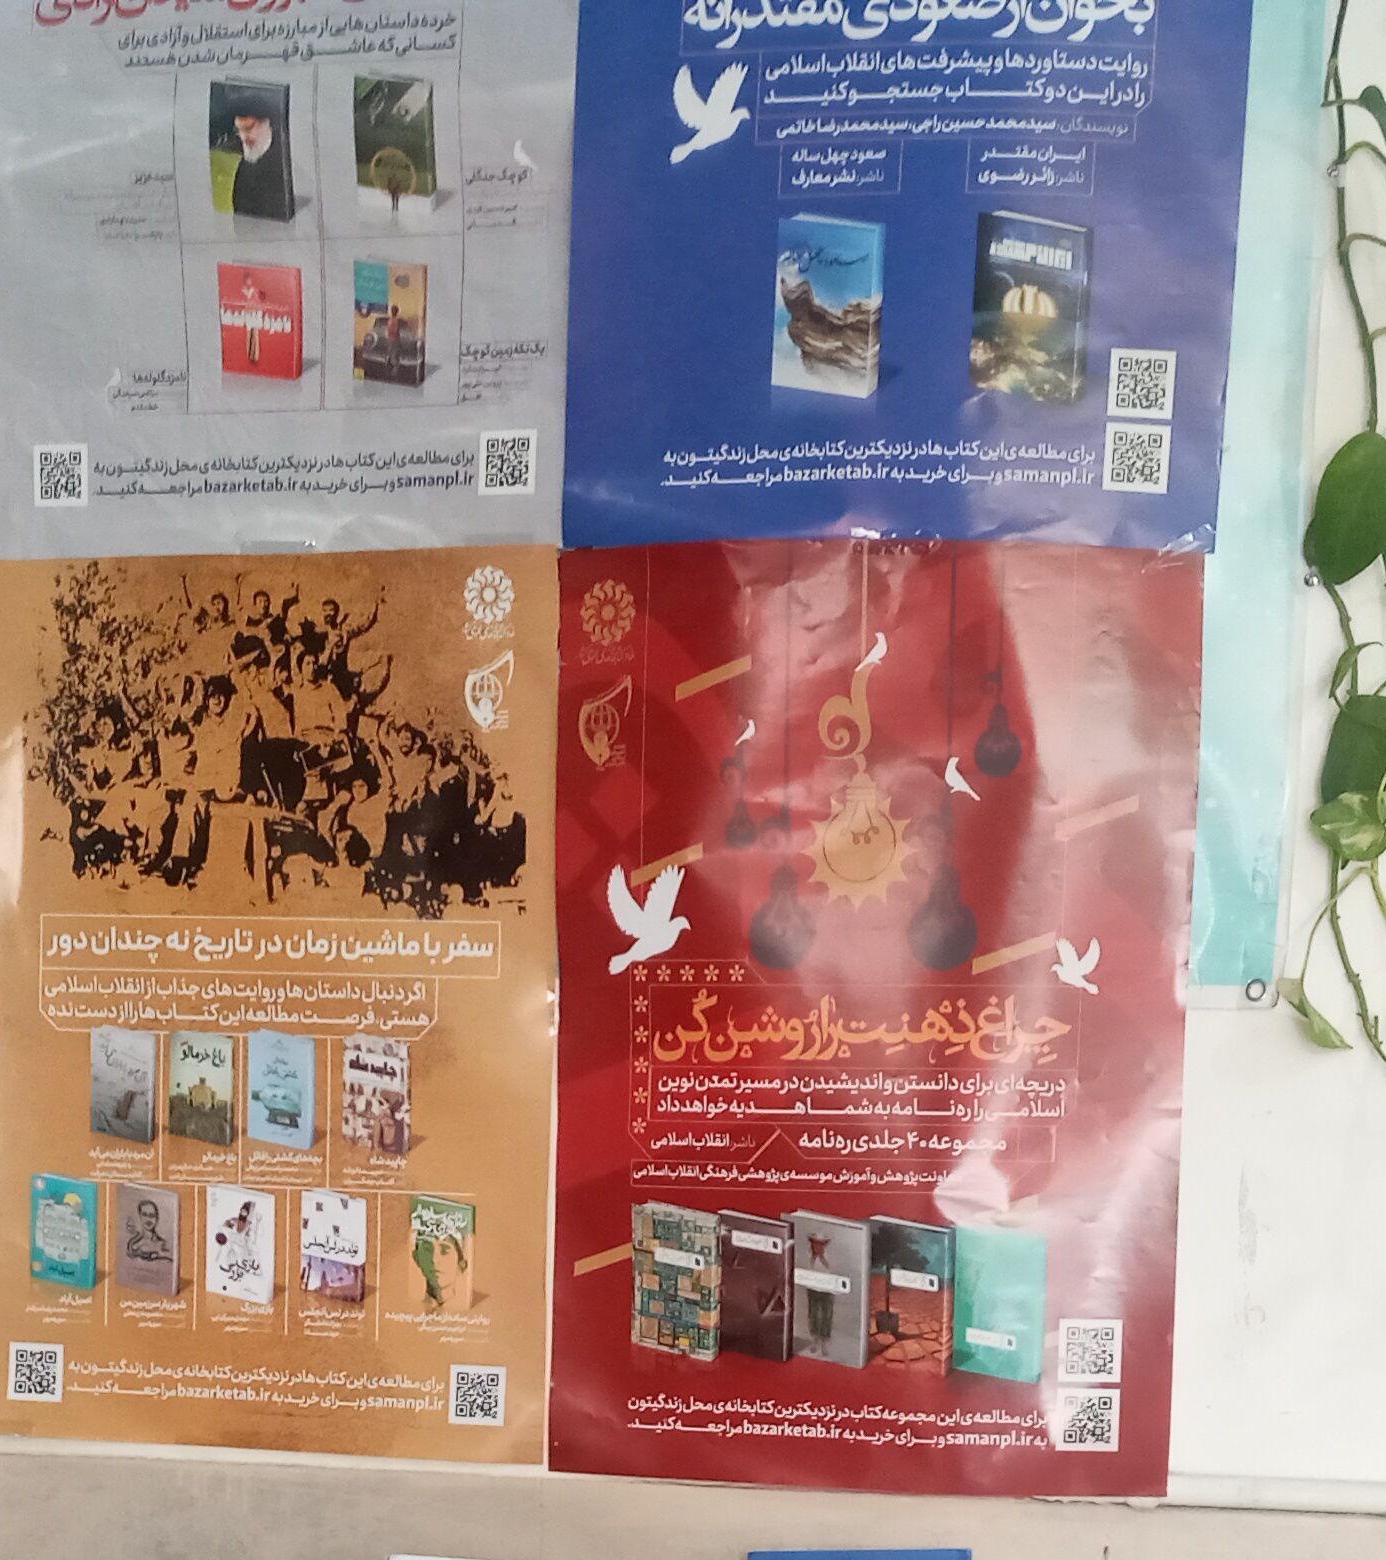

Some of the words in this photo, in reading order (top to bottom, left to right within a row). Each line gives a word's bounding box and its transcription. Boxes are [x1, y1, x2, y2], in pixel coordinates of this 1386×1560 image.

[765, 53, 826, 81] اسلامی
[826, 51, 881, 79] انقلاب
[1098, 52, 1148, 79] روایت
[763, 80, 849, 107] کنید
[848, 82, 944, 107] جستجو
[945, 77, 1047, 103] کتاب
[1066, 79, 1115, 105] این
[1112, 86, 1133, 107] در
[1133, 82, 1146, 108] را
[776, 117, 816, 139] خاتمی
[791, 146, 820, 163] ساله
[820, 146, 850, 166] چهل
[850, 148, 887, 165] صعود
[979, 143, 1037, 163] مقتدر
[1037, 145, 1087, 165] ایران
[791, 167, 830, 189] معارف
[375, 451, 396, 470] این
[451, 450, 475, 467] برای
[663, 448, 677, 468] به
[747, 443, 779, 464] محل
[979, 441, 1004, 461] این
[1067, 445, 1096, 466] برای
[169, 457, 199, 476] محل
[783, 463, 890, 482] bazarketab.ir
[890, 466, 906, 484] به
[905, 464, 947, 484] خرید
[947, 464, 994, 485] برای
[204, 475, 297, 495] bazarketab.ir
[312, 479, 348, 494] خرید
[349, 475, 387, 494] برای
[396, 470, 475, 490] samanpl.ir
[711, 467, 783, 488] مراجعه
[1004, 466, 1095, 488] samanpl.ir
[45, 930, 91, 957] دور
[91, 928, 162, 964] چندان
[166, 931, 193, 955] نه
[193, 927, 254, 962] تاریخ
[255, 932, 285, 963] در
[286, 928, 339, 962] زمان
[339, 930, 422, 963] ماشین
[422, 931, 442, 964] با
[442, 934, 495, 965] سفر
[43, 974, 98, 998] اسلامی
[97, 976, 145, 999] انقلاب
[144, 977, 156, 1000] از
[156, 976, 201, 1000] جذاب
[361, 980, 403, 1004] دنبال
[402, 982, 427, 1006] اگر
[47, 1003, 74, 1019] نده
[74, 1004, 118, 1019] دست
[219, 1003, 245, 1027] این
[245, 1004, 300, 1024] مطالعه
[300, 1006, 376, 1030] فرصت
[658, 1071, 695, 1092] نوین
[695, 1072, 737, 1092] تمدن
[735, 1076, 779, 1095] مسیر
[778, 1076, 799, 1095] در
[799, 1072, 883, 1096] اندیشیدن
[893, 1072, 958, 1095] دانستن
[959, 1073, 993, 1096] برای
[657, 1095, 681, 1113] داد
[680, 1095, 728, 1118] خواهد
[729, 1101, 807, 1119] هدیه
[806, 1096, 873, 1116] شما
[874, 1101, 892, 1120] به
[984, 1098, 1065, 1121] اسلامی
[650, 1131, 693, 1150] اسلامی
[692, 1132, 730, 1151] انقلاب
[852, 1129, 905, 1155] جلدی
[632, 1163, 668, 1179] اسلامی
[667, 1164, 700, 1182] انقلاب
[699, 1163, 738, 1182] فرهنگی
[737, 1168, 780, 1184] پژوهشی
[832, 1167, 871, 1184] آموزش
[876, 1168, 918, 1187] پژوهش
[144, 1362, 172, 1379] محل
[176, 1383, 271, 1403] bazarketab.ir
[420, 1375, 446, 1395] برای
[283, 1391, 320, 1409] خرید
[320, 1392, 359, 1411] برای
[368, 1395, 445, 1412] samanpl.ir
[683, 1395, 713, 1413] محل
[850, 1404, 883, 1423] کتاب
[881, 1410, 936, 1425] مجموعه
[936, 1408, 960, 1426] این
[1021, 1409, 1049, 1429] برای
[674, 1419, 742, 1437] مراجعه
[742, 1420, 843, 1439] bazarketab.ir
[842, 1426, 856, 1443] به
[855, 1428, 895, 1446] خرید
[895, 1428, 937, 1448] برای
[946, 1430, 1034, 1449] samanpl.ir
